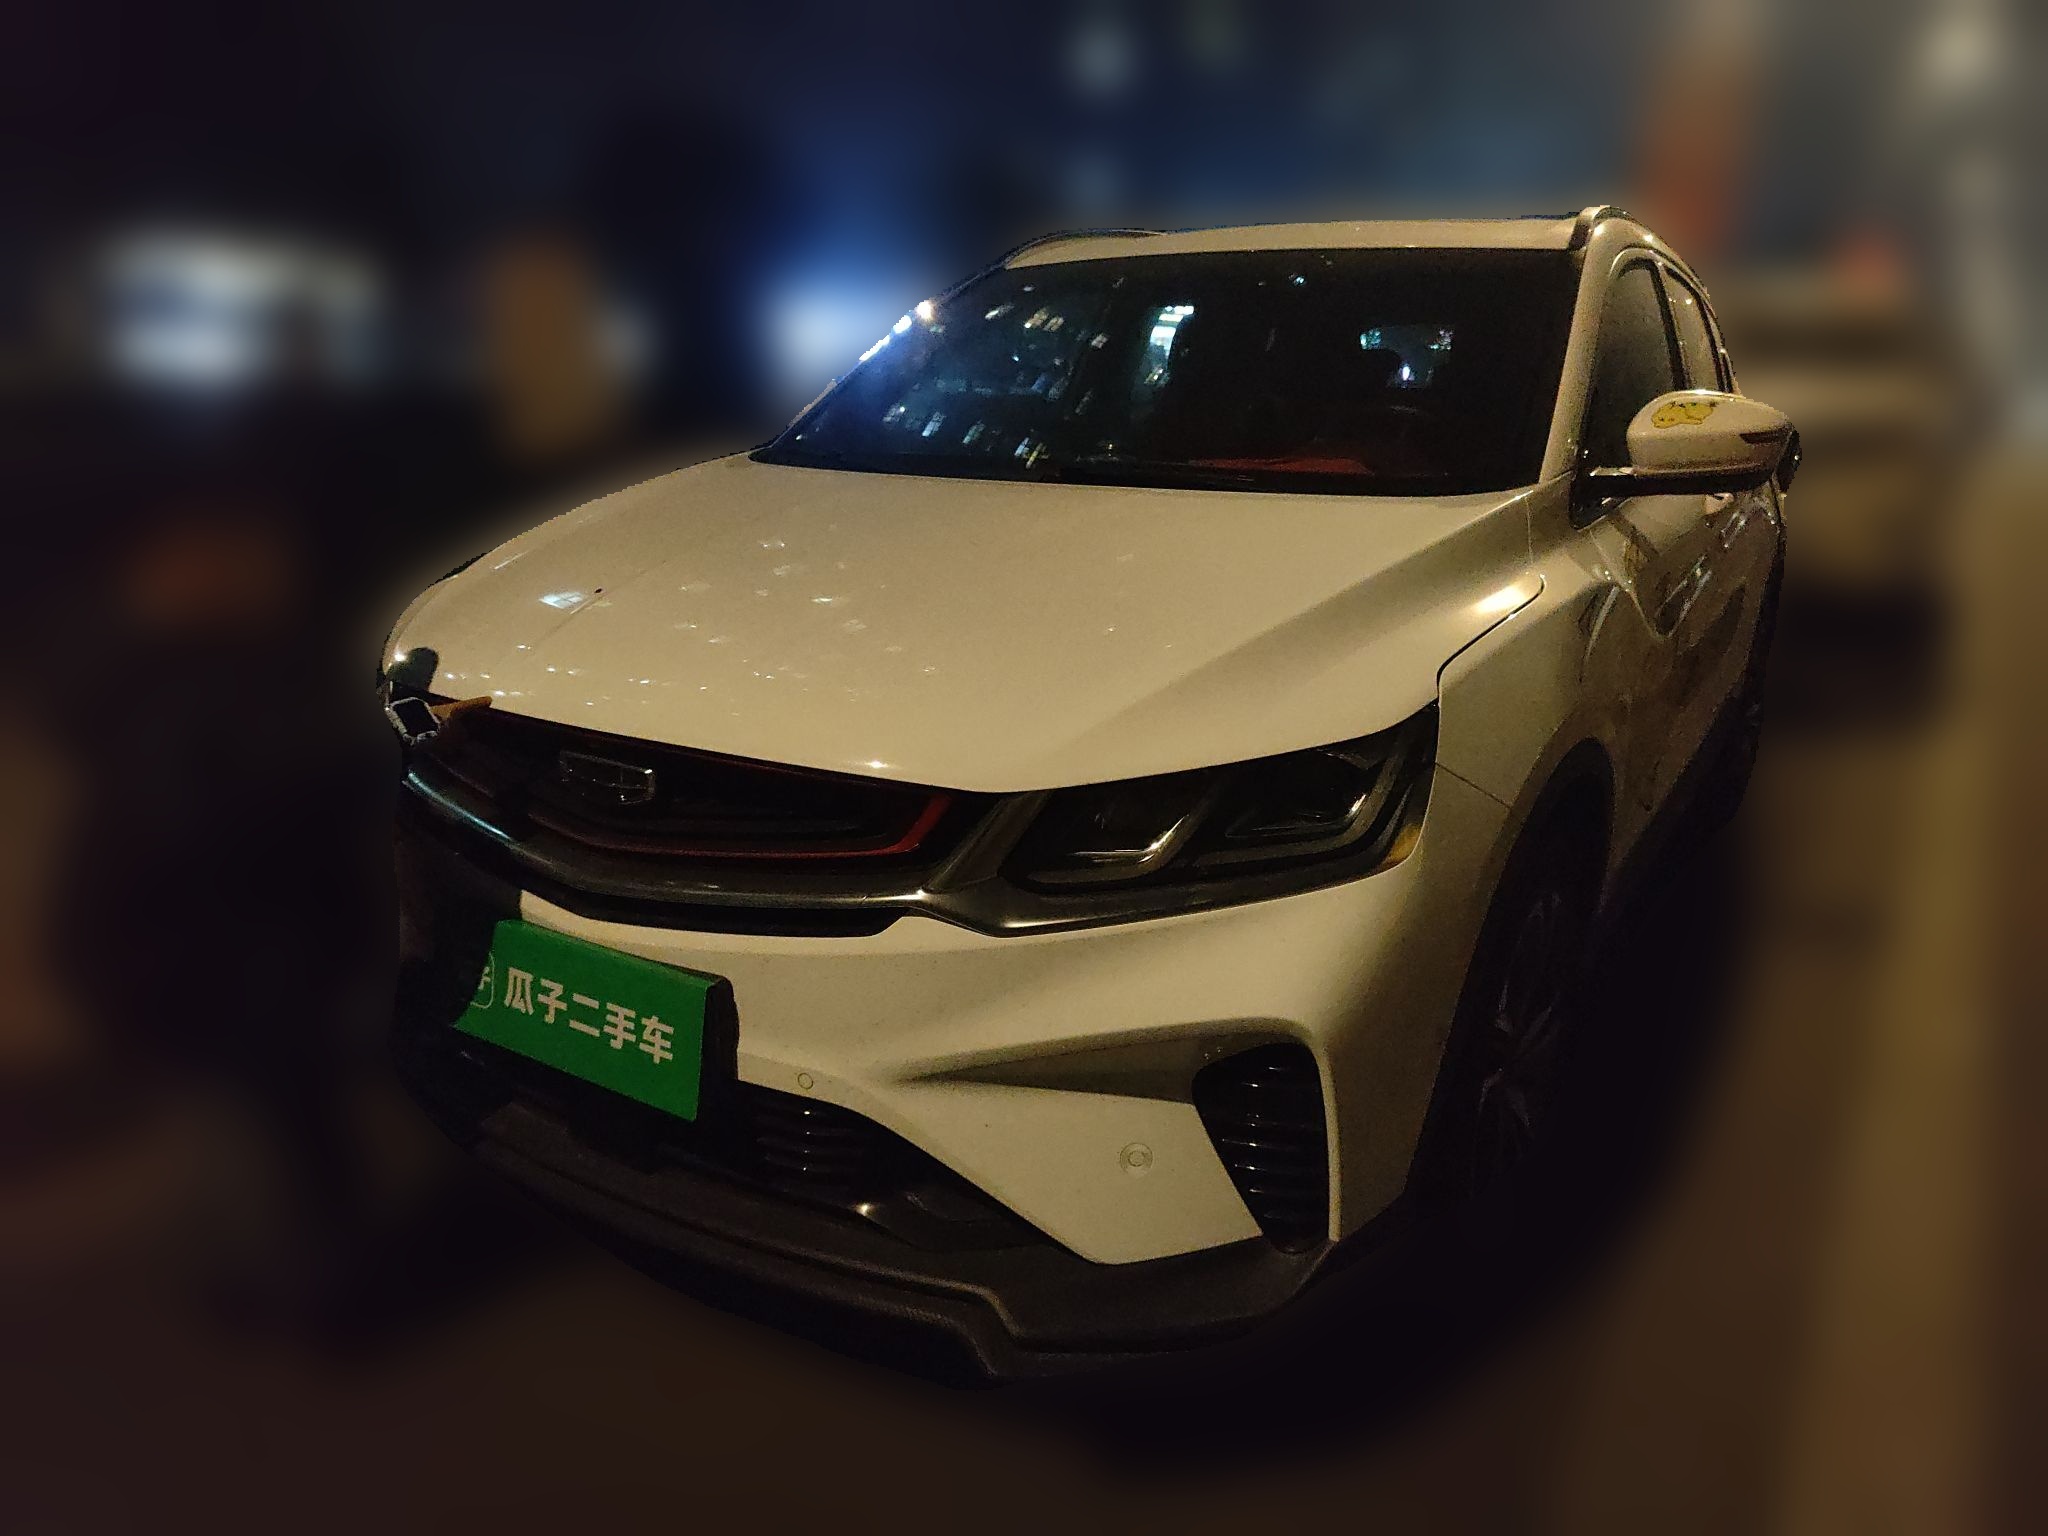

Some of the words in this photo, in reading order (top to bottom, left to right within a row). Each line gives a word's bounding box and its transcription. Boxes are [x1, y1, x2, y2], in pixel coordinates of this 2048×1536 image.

[504, 966, 675, 1065] 瓜子二手车
